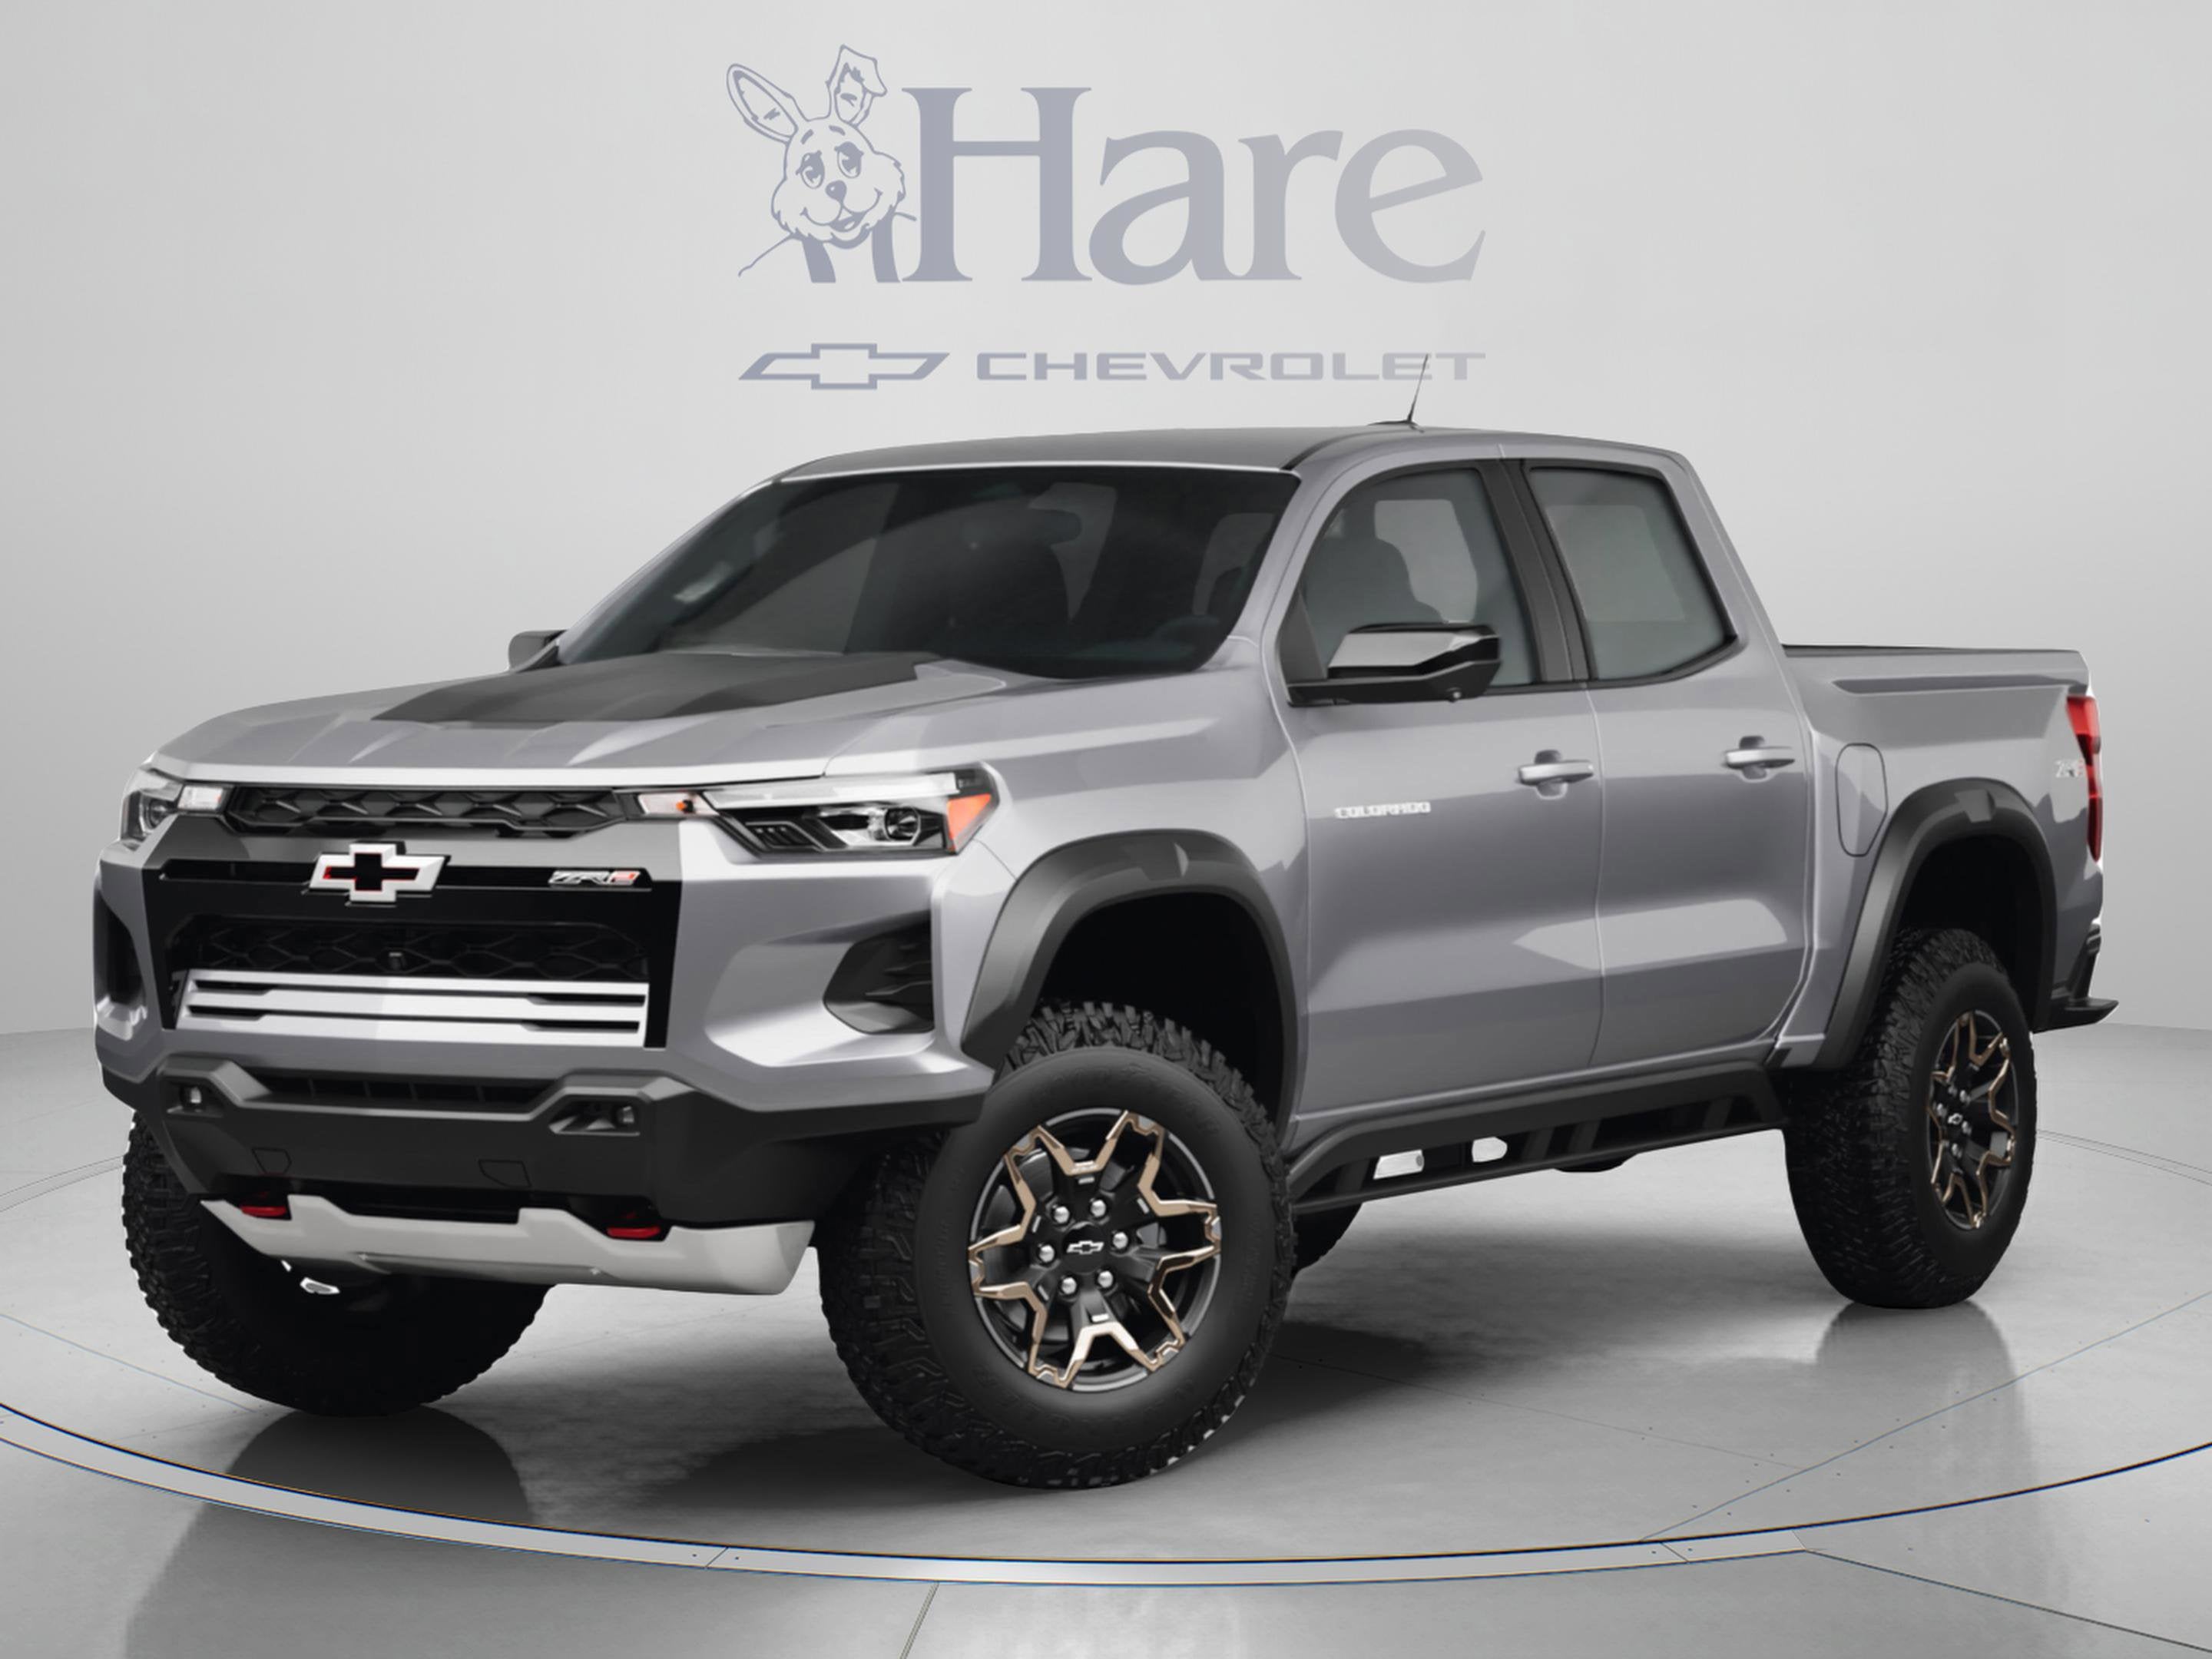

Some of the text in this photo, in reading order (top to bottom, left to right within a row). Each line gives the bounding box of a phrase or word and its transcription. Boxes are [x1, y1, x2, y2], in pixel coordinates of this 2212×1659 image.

[901, 86, 1486, 286] Hare
[976, 352, 1486, 381] CHEVROLET
[1335, 801, 1432, 820] COLORADO
